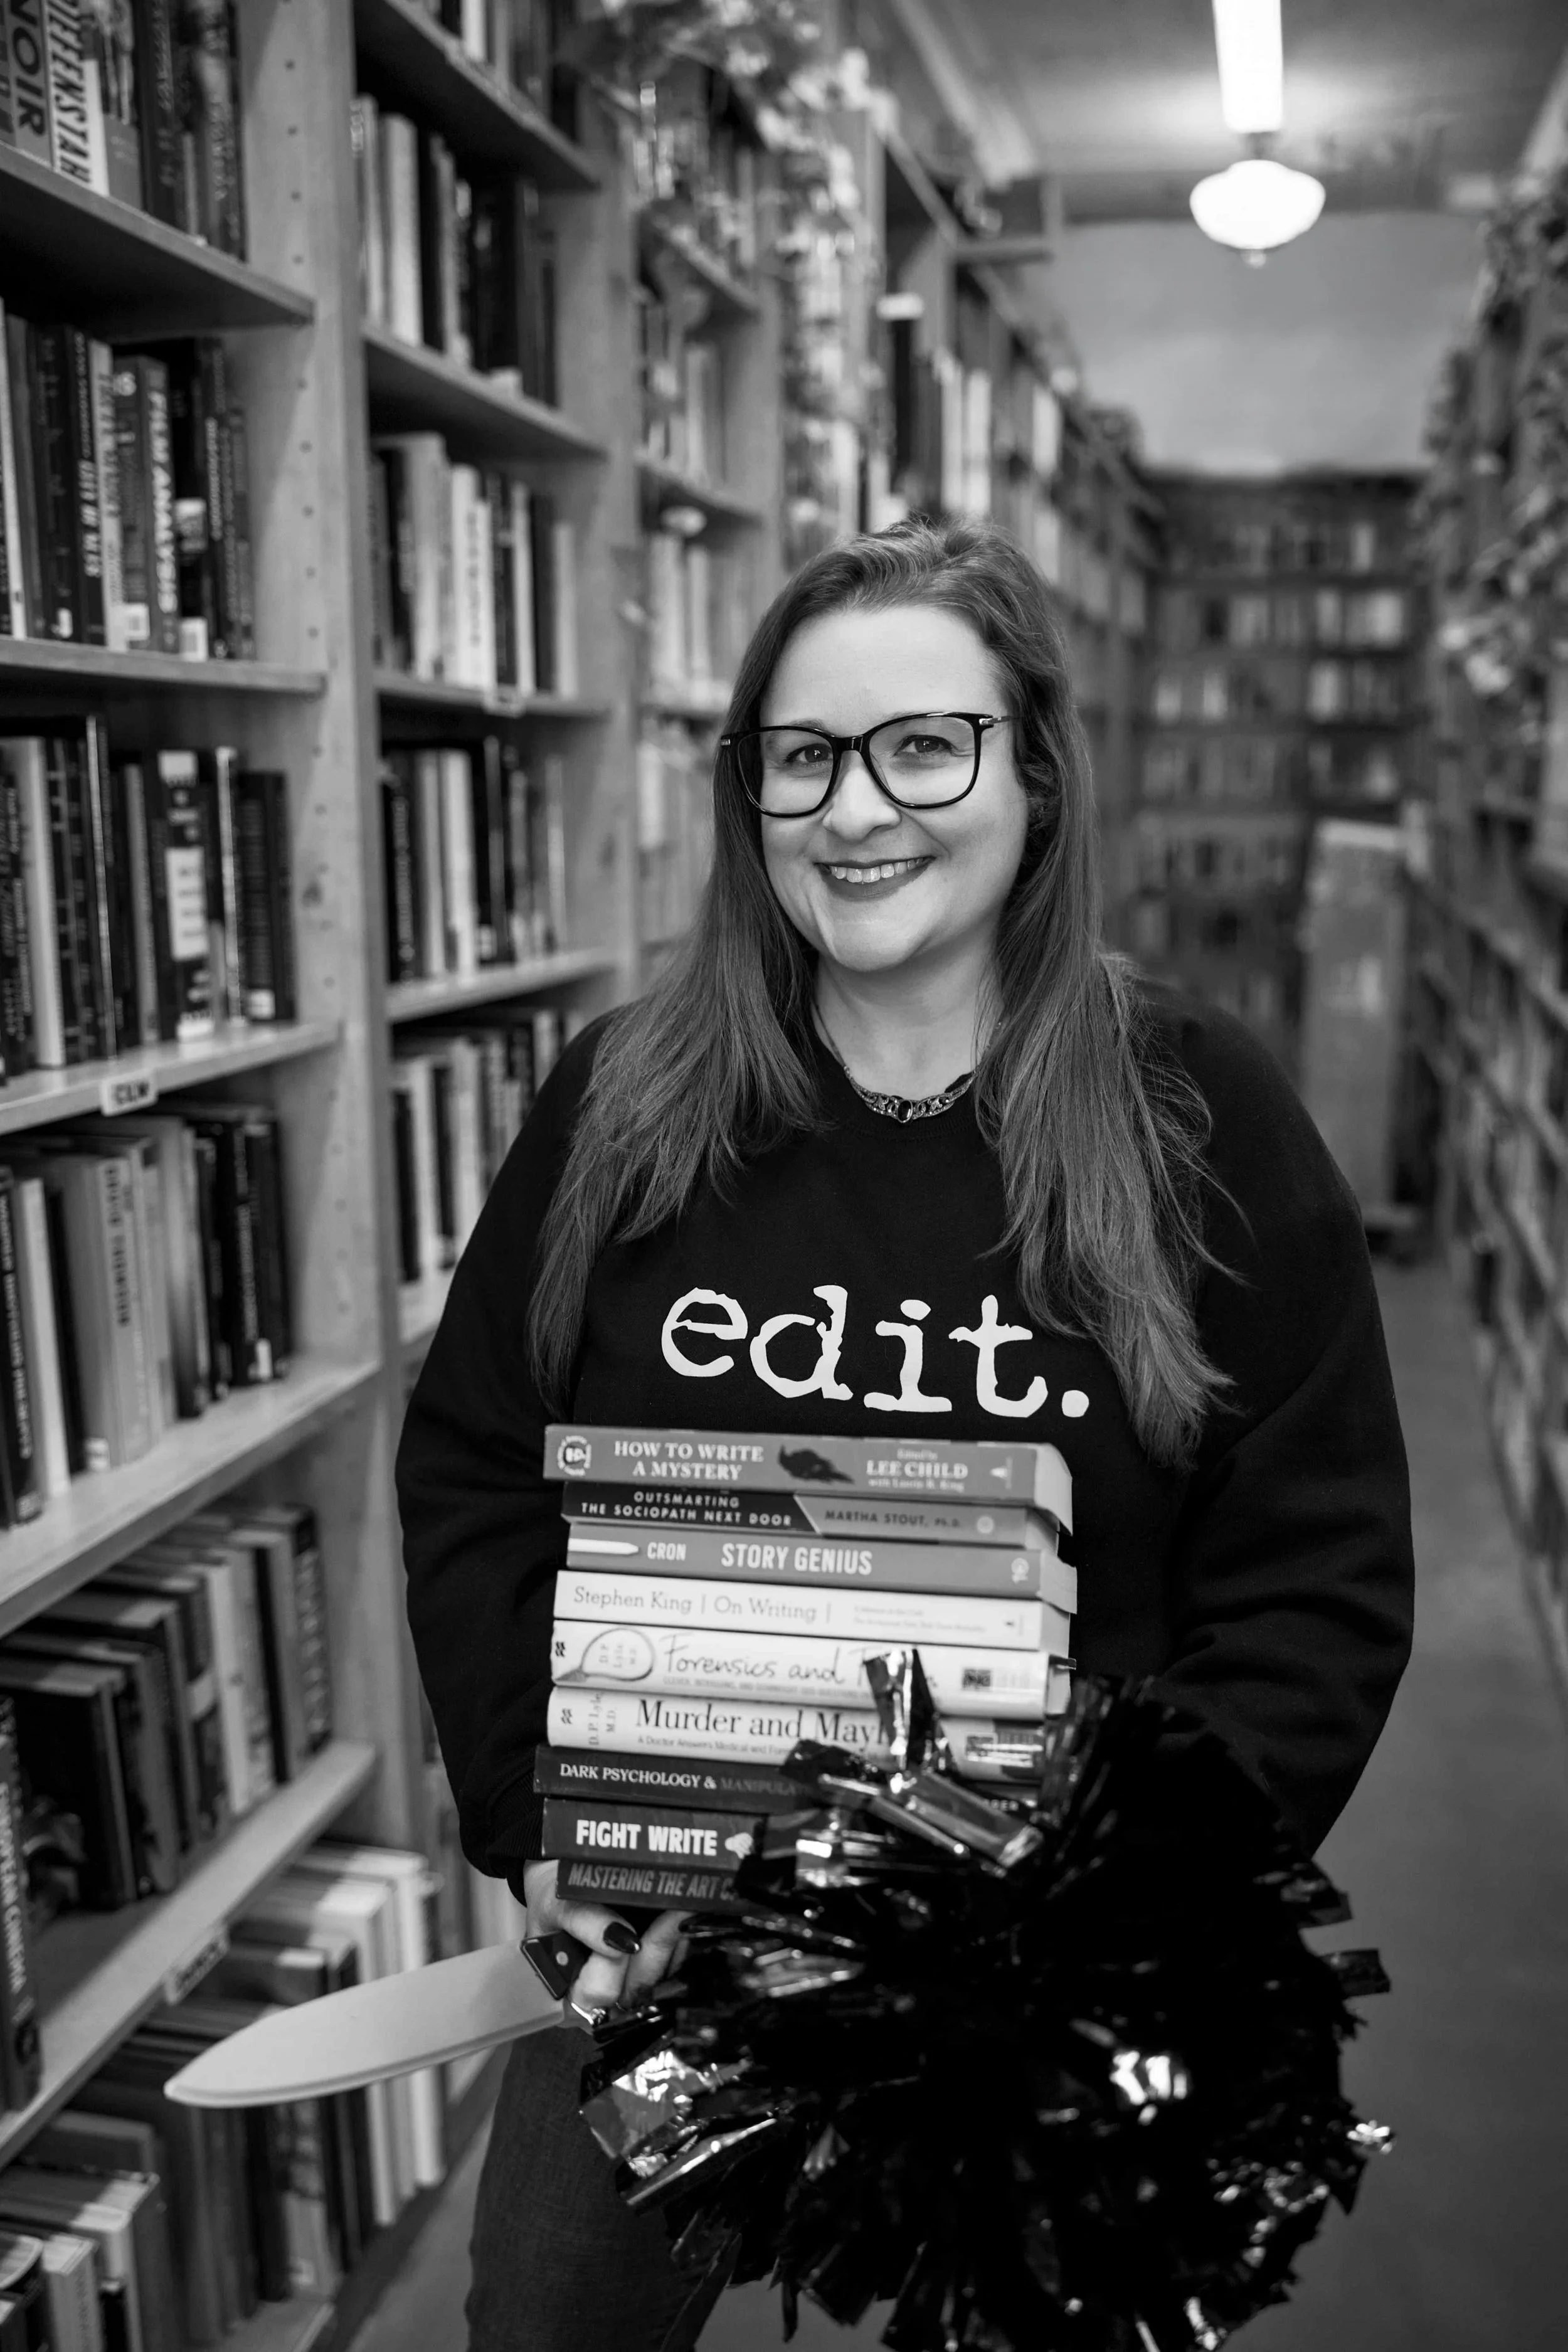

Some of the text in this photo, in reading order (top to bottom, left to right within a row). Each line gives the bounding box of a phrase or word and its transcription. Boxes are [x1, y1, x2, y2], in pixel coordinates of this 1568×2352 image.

[147, 390, 178, 613] FILM ANALYSIS
[662, 1285, 1089, 1417] edit.
[614, 1441, 765, 1463] HOW TO WRITE
[632, 1460, 742, 1481] A MYSTERY
[867, 1459, 969, 1480] LEE CHILD
[633, 1490, 740, 1508] OUTSMARTING
[581, 1502, 792, 1527] THE SOCIOPATH NEXT DOOR
[825, 1510, 878, 1524] MARTHA
[647, 1541, 687, 1562] CRON
[721, 1542, 873, 1576] STORY GENIUS
[573, 1586, 692, 1616] Stephen King
[713, 1595, 817, 1624] On Writing
[659, 1631, 776, 1678] Forensics
[788, 1646, 846, 1685] and
[636, 1698, 742, 1733] Murder
[750, 1709, 803, 1738] and
[560, 1763, 598, 1779] DARK
[602, 1766, 701, 1789] PSYCHOLOGY
[703, 1775, 718, 1790] &
[576, 1819, 718, 1857] FIGHT WRITE
[568, 1862, 655, 1894] MASTERING
[657, 1870, 687, 1895] THE
[686, 1874, 721, 1900] ART
